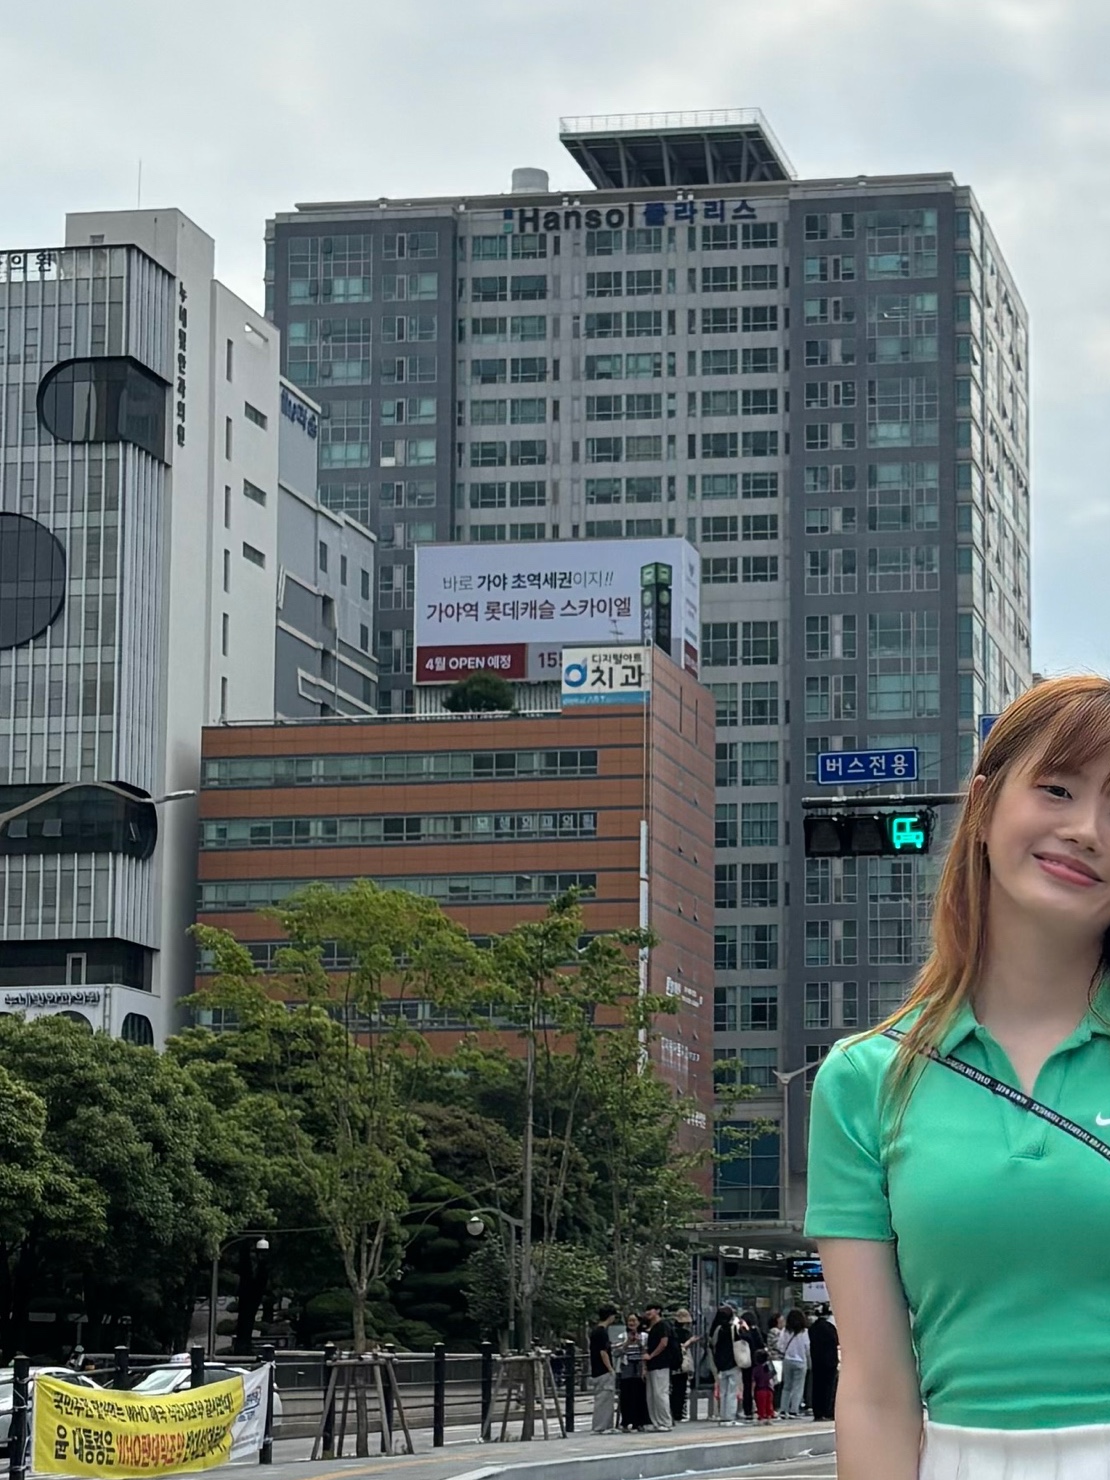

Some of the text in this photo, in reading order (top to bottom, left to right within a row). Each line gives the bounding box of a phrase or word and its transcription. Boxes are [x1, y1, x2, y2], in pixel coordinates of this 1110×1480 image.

[519, 203, 634, 233] Hansol
[443, 575, 474, 592] 바로
[477, 573, 508, 590] 가야
[427, 597, 632, 623] 가야역 롯데캐슬 스카이엘
[425, 654, 512, 671] 4월 OPEN 예정
[825, 753, 909, 776] 버스전용
[125, 1405, 149, 1423] WHO
[55, 1425, 69, 1460] 윤
[72, 1427, 116, 1465] 대통령은
